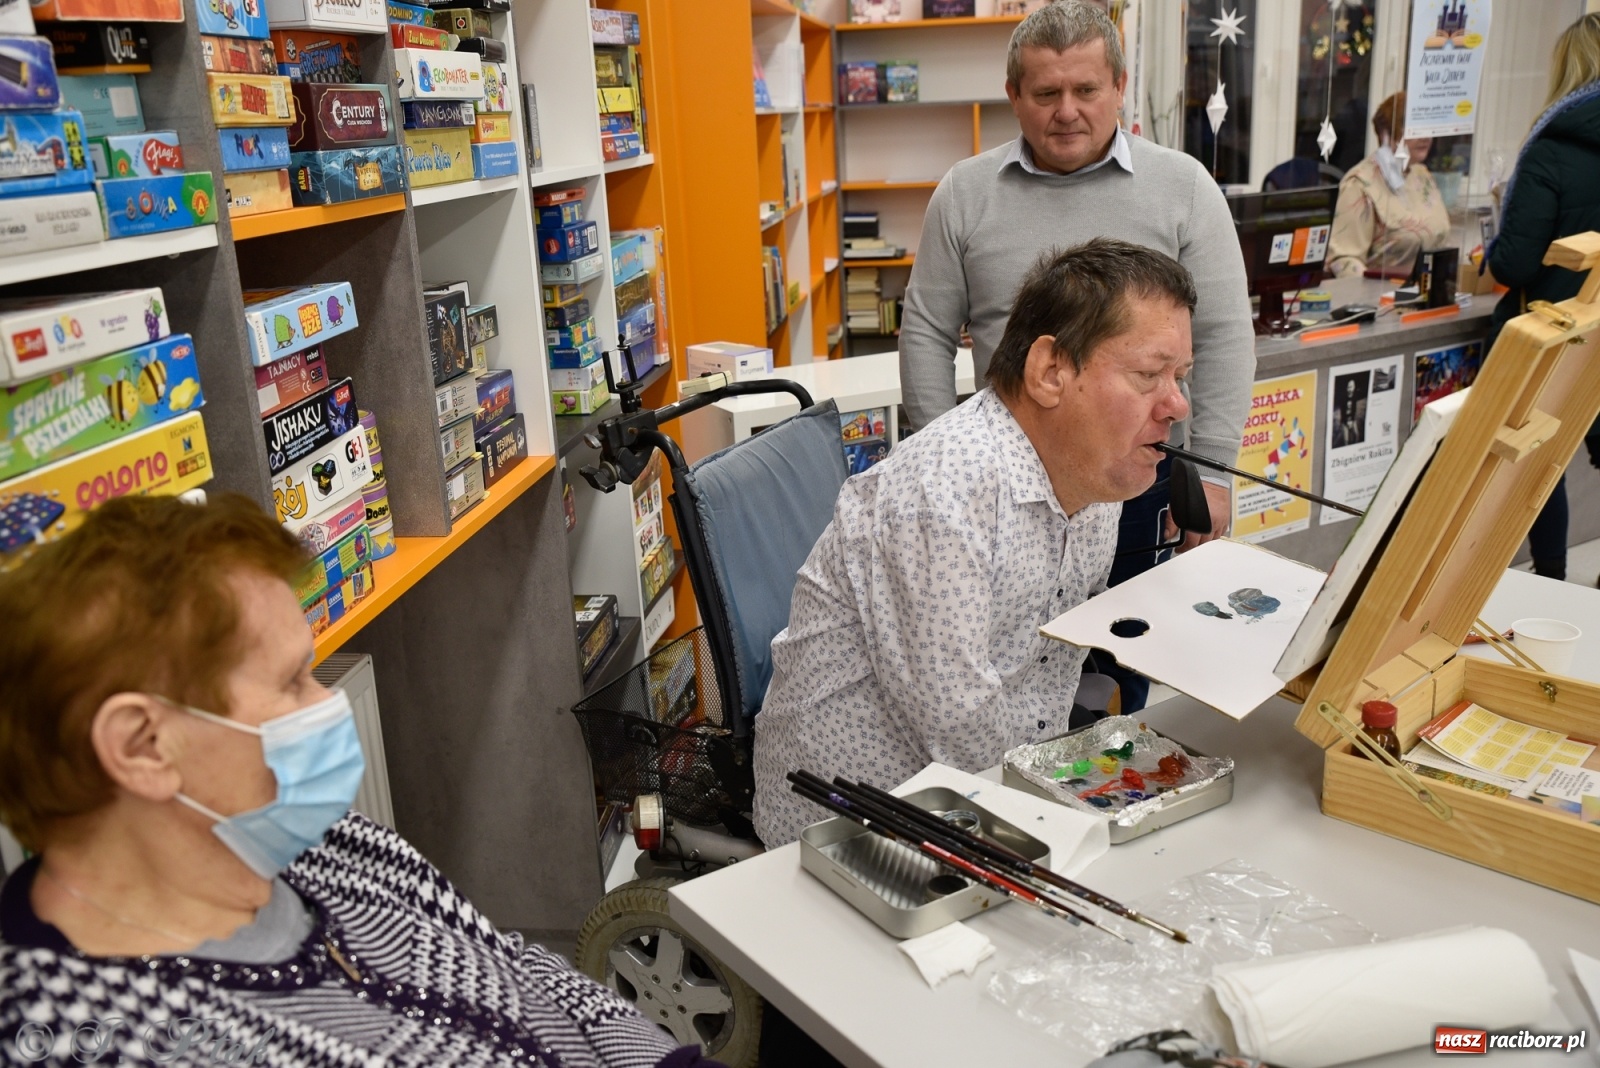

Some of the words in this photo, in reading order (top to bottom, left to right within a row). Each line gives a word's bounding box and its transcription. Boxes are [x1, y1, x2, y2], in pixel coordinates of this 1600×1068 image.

[331, 98, 375, 129] CENTURY
[406, 146, 434, 174] Puerto
[432, 141, 452, 171] Rico
[267, 353, 301, 379] TAJNIACY
[306, 349, 320, 362] rebel
[13, 372, 87, 436] SPRYTNE
[1251, 388, 1301, 409] SIĄŻKA
[22, 394, 110, 460] PSZCZÓŁKI
[170, 420, 200, 440] EGMONT
[271, 403, 322, 452] JISHAKU
[1242, 430, 1270, 448] 2021
[1331, 453, 1366, 469] Zbigniew
[1368, 446, 1393, 460] Rokita
